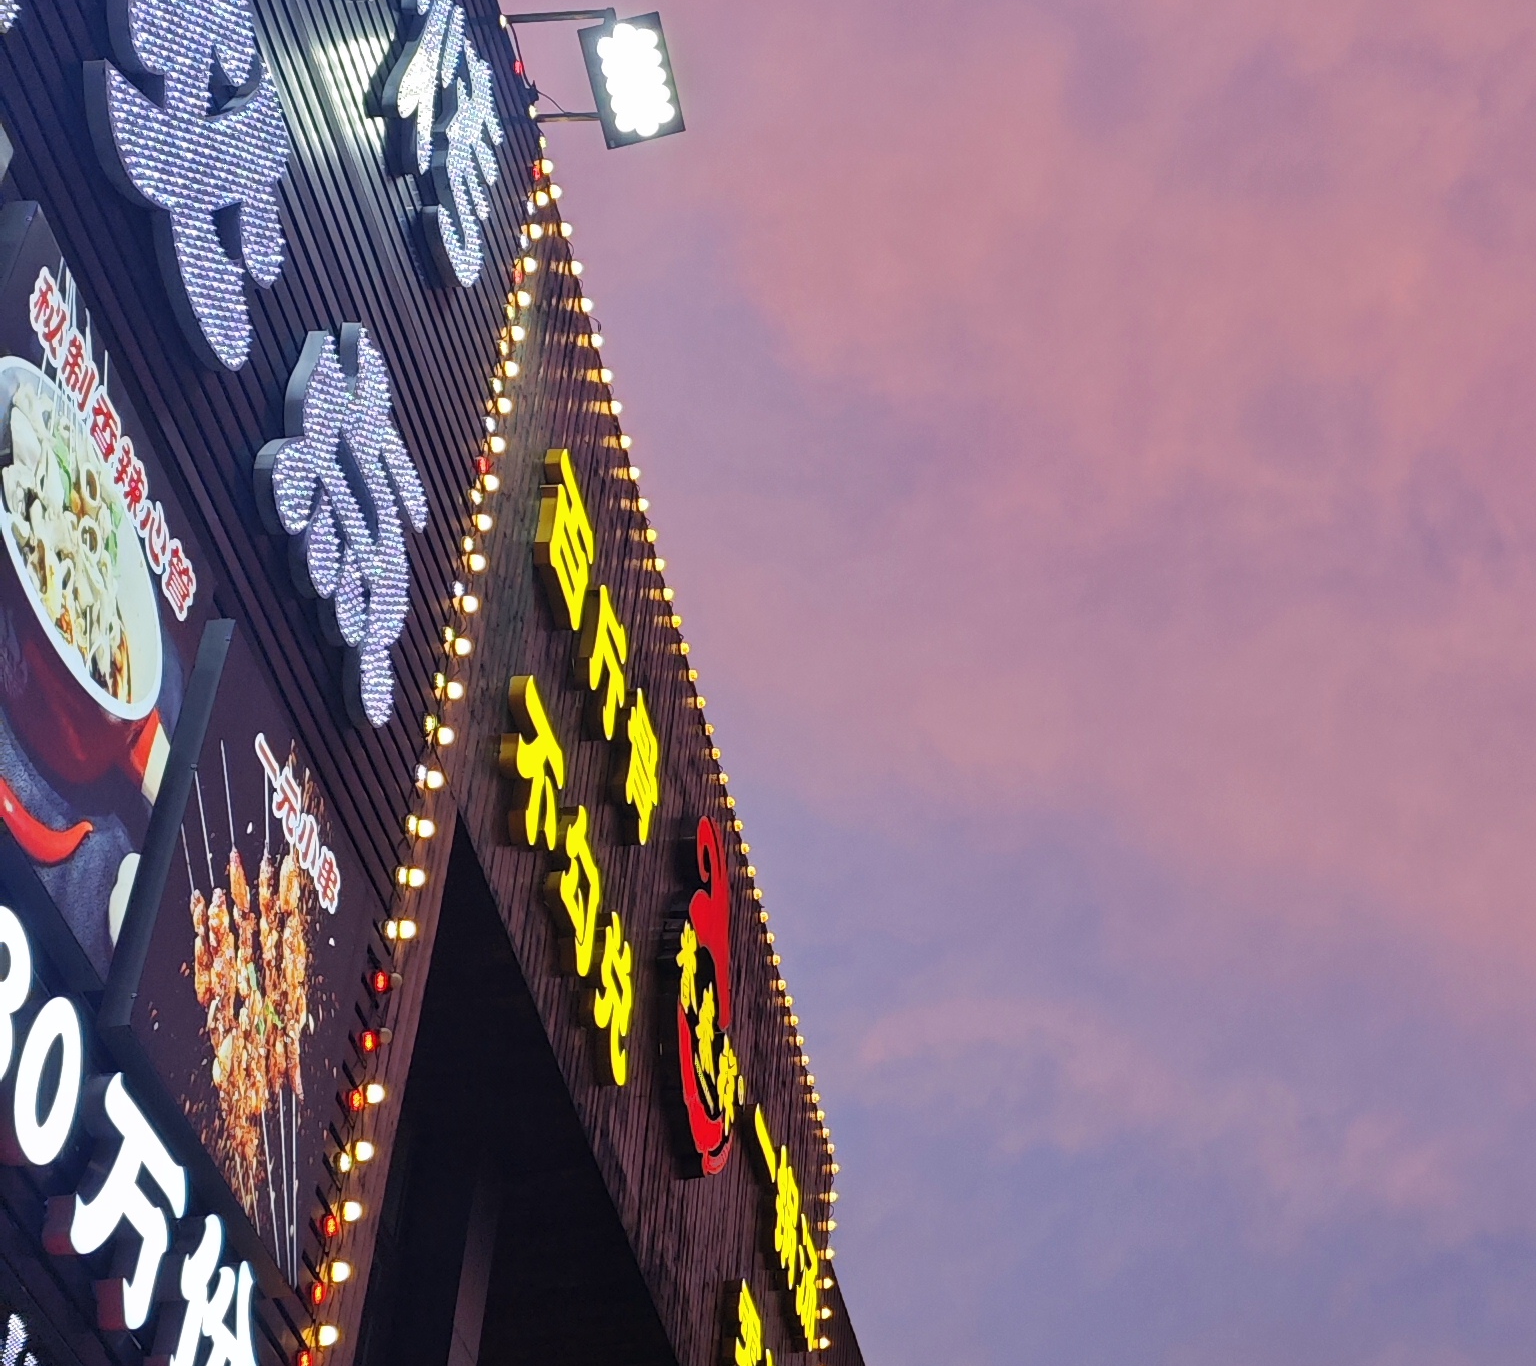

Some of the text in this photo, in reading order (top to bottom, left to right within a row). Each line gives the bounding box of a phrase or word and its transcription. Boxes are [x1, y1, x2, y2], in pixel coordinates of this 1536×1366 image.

[29, 266, 195, 623] 秘制香辣心管
[255, 732, 340, 913] 一元小串
[549, 448, 659, 846] 百斤骨
[517, 675, 632, 1087] 不勾兑
[754, 1103, 819, 1352] 一锅汤
